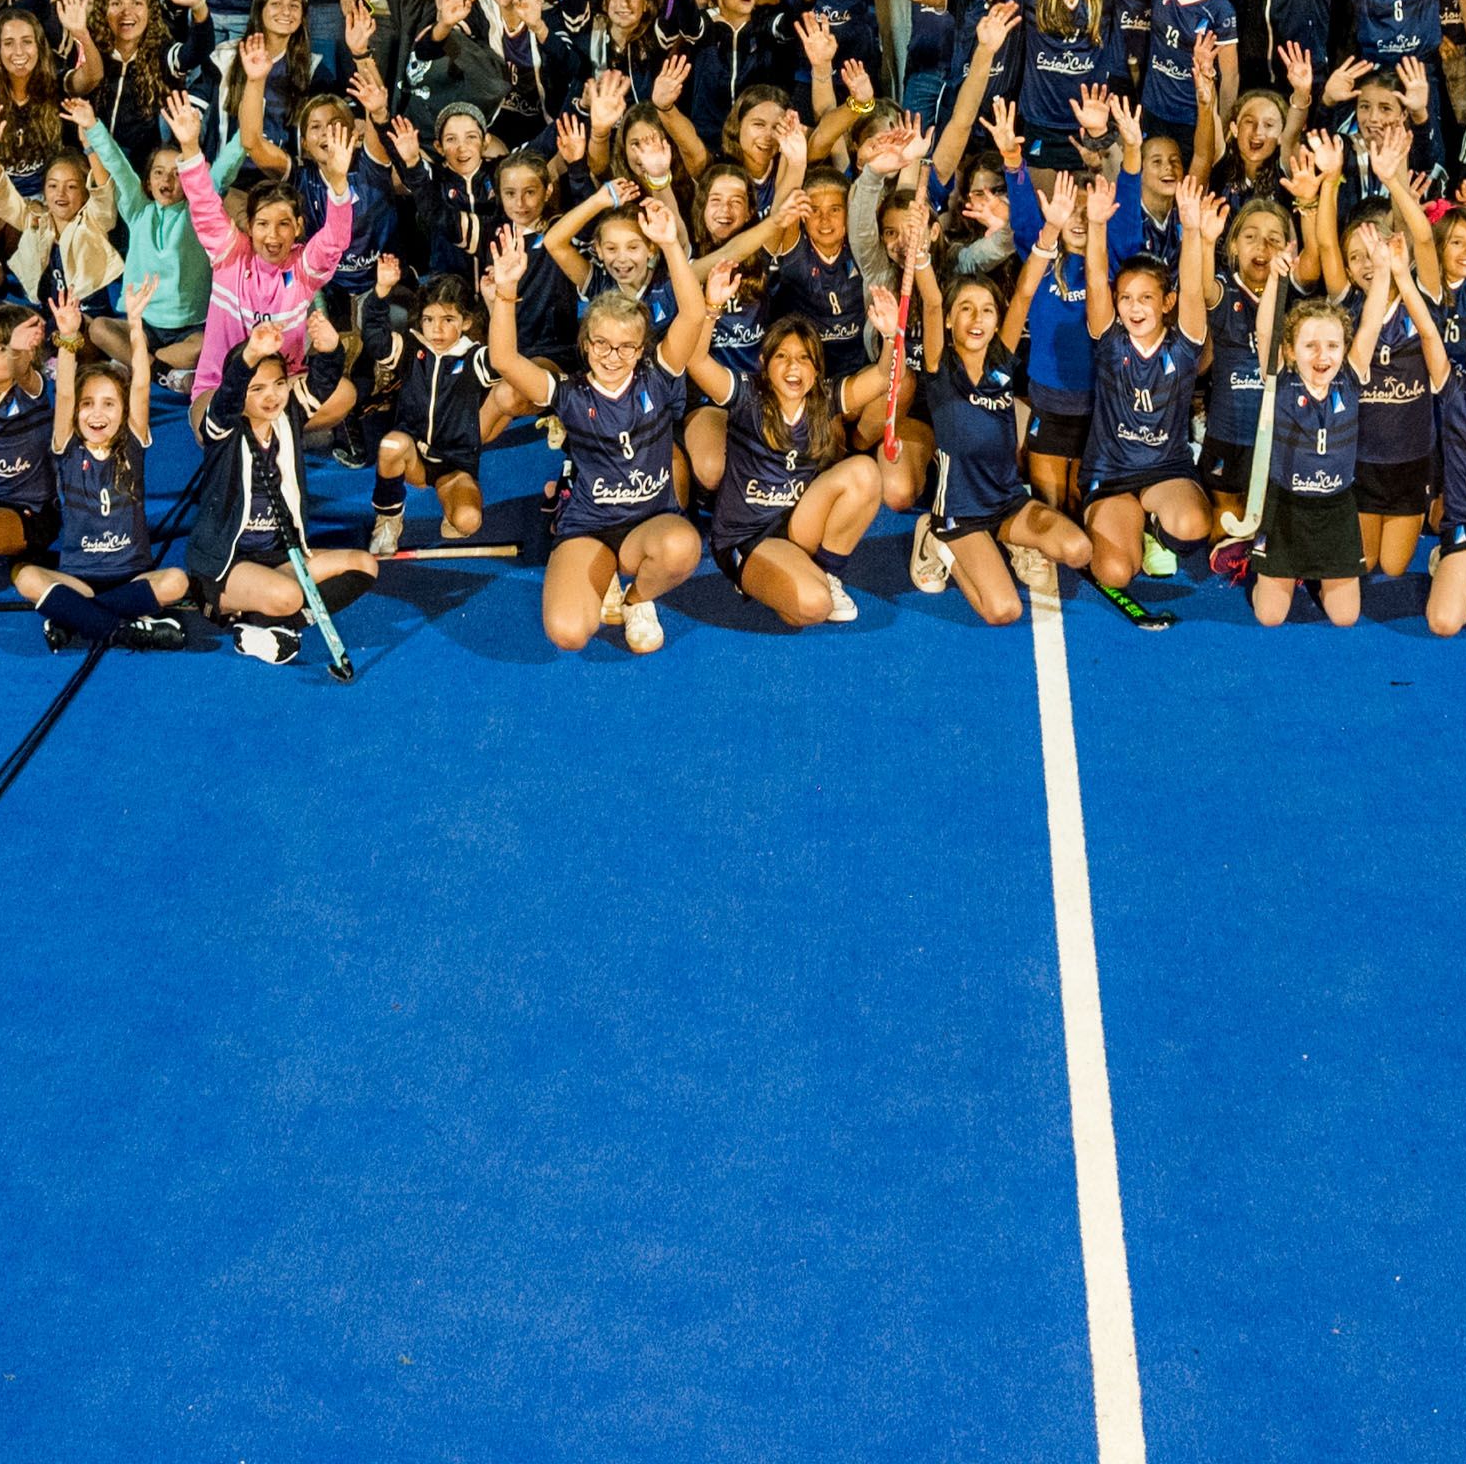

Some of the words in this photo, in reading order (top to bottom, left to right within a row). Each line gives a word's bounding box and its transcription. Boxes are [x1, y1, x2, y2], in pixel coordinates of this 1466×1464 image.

[1395, 0, 1403, 21] 6
[1444, 314, 1460, 343] 15
[1133, 380, 1154, 412] 20
[619, 430, 635, 461] 3
[1316, 428, 1327, 454] 8
[100, 491, 111, 517] 9
